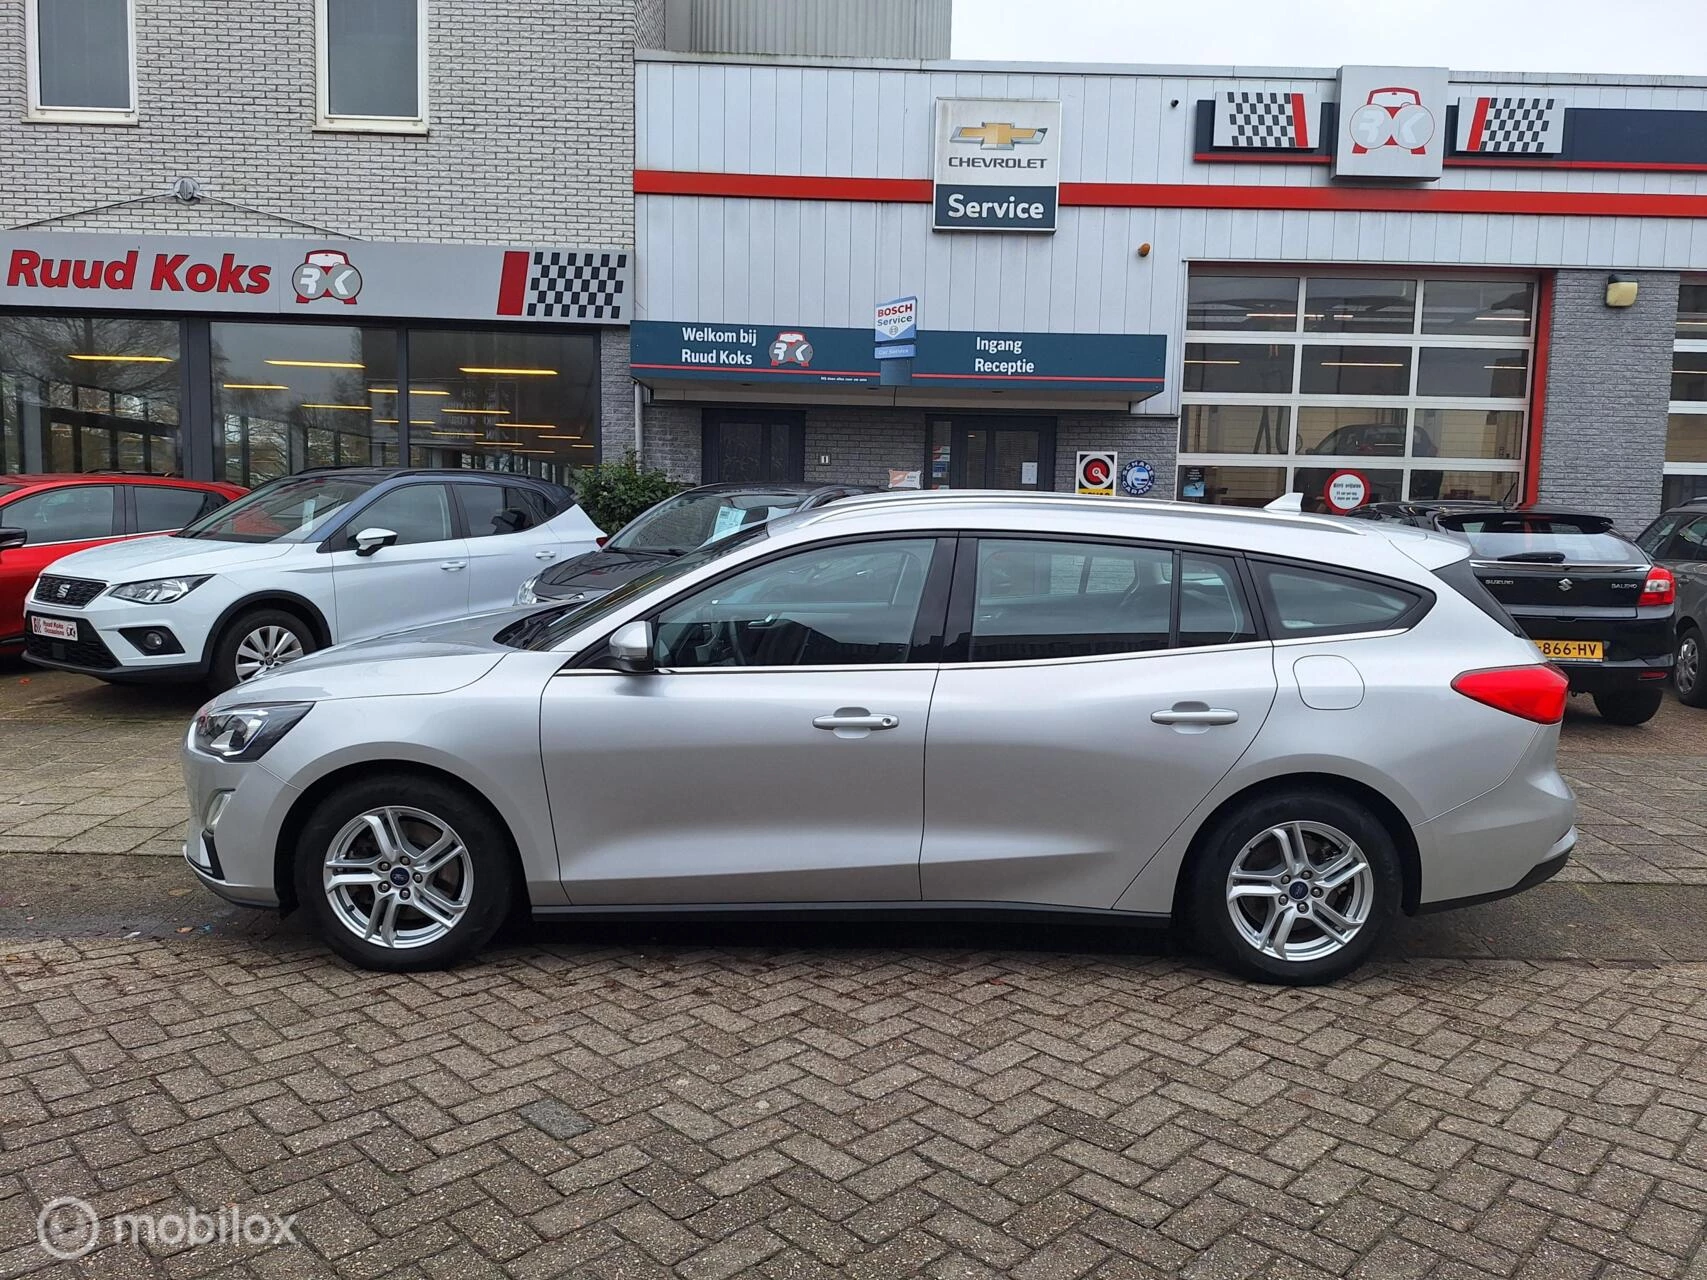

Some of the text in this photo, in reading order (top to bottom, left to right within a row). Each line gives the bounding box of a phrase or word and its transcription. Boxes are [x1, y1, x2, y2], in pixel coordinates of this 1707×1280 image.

[948, 157, 1047, 169] CHEVROLET
[947, 193, 1044, 219] Service
[7, 248, 272, 295] Ruud Koks
[877, 303, 913, 318] BOSCH
[877, 315, 913, 327] Service
[682, 327, 757, 347] Welkom bij
[976, 336, 1022, 355] Ingang
[681, 349, 753, 365] Ruud Koks
[974, 358, 1035, 376] Receptie
[1121, 460, 1155, 477] SCHADE
